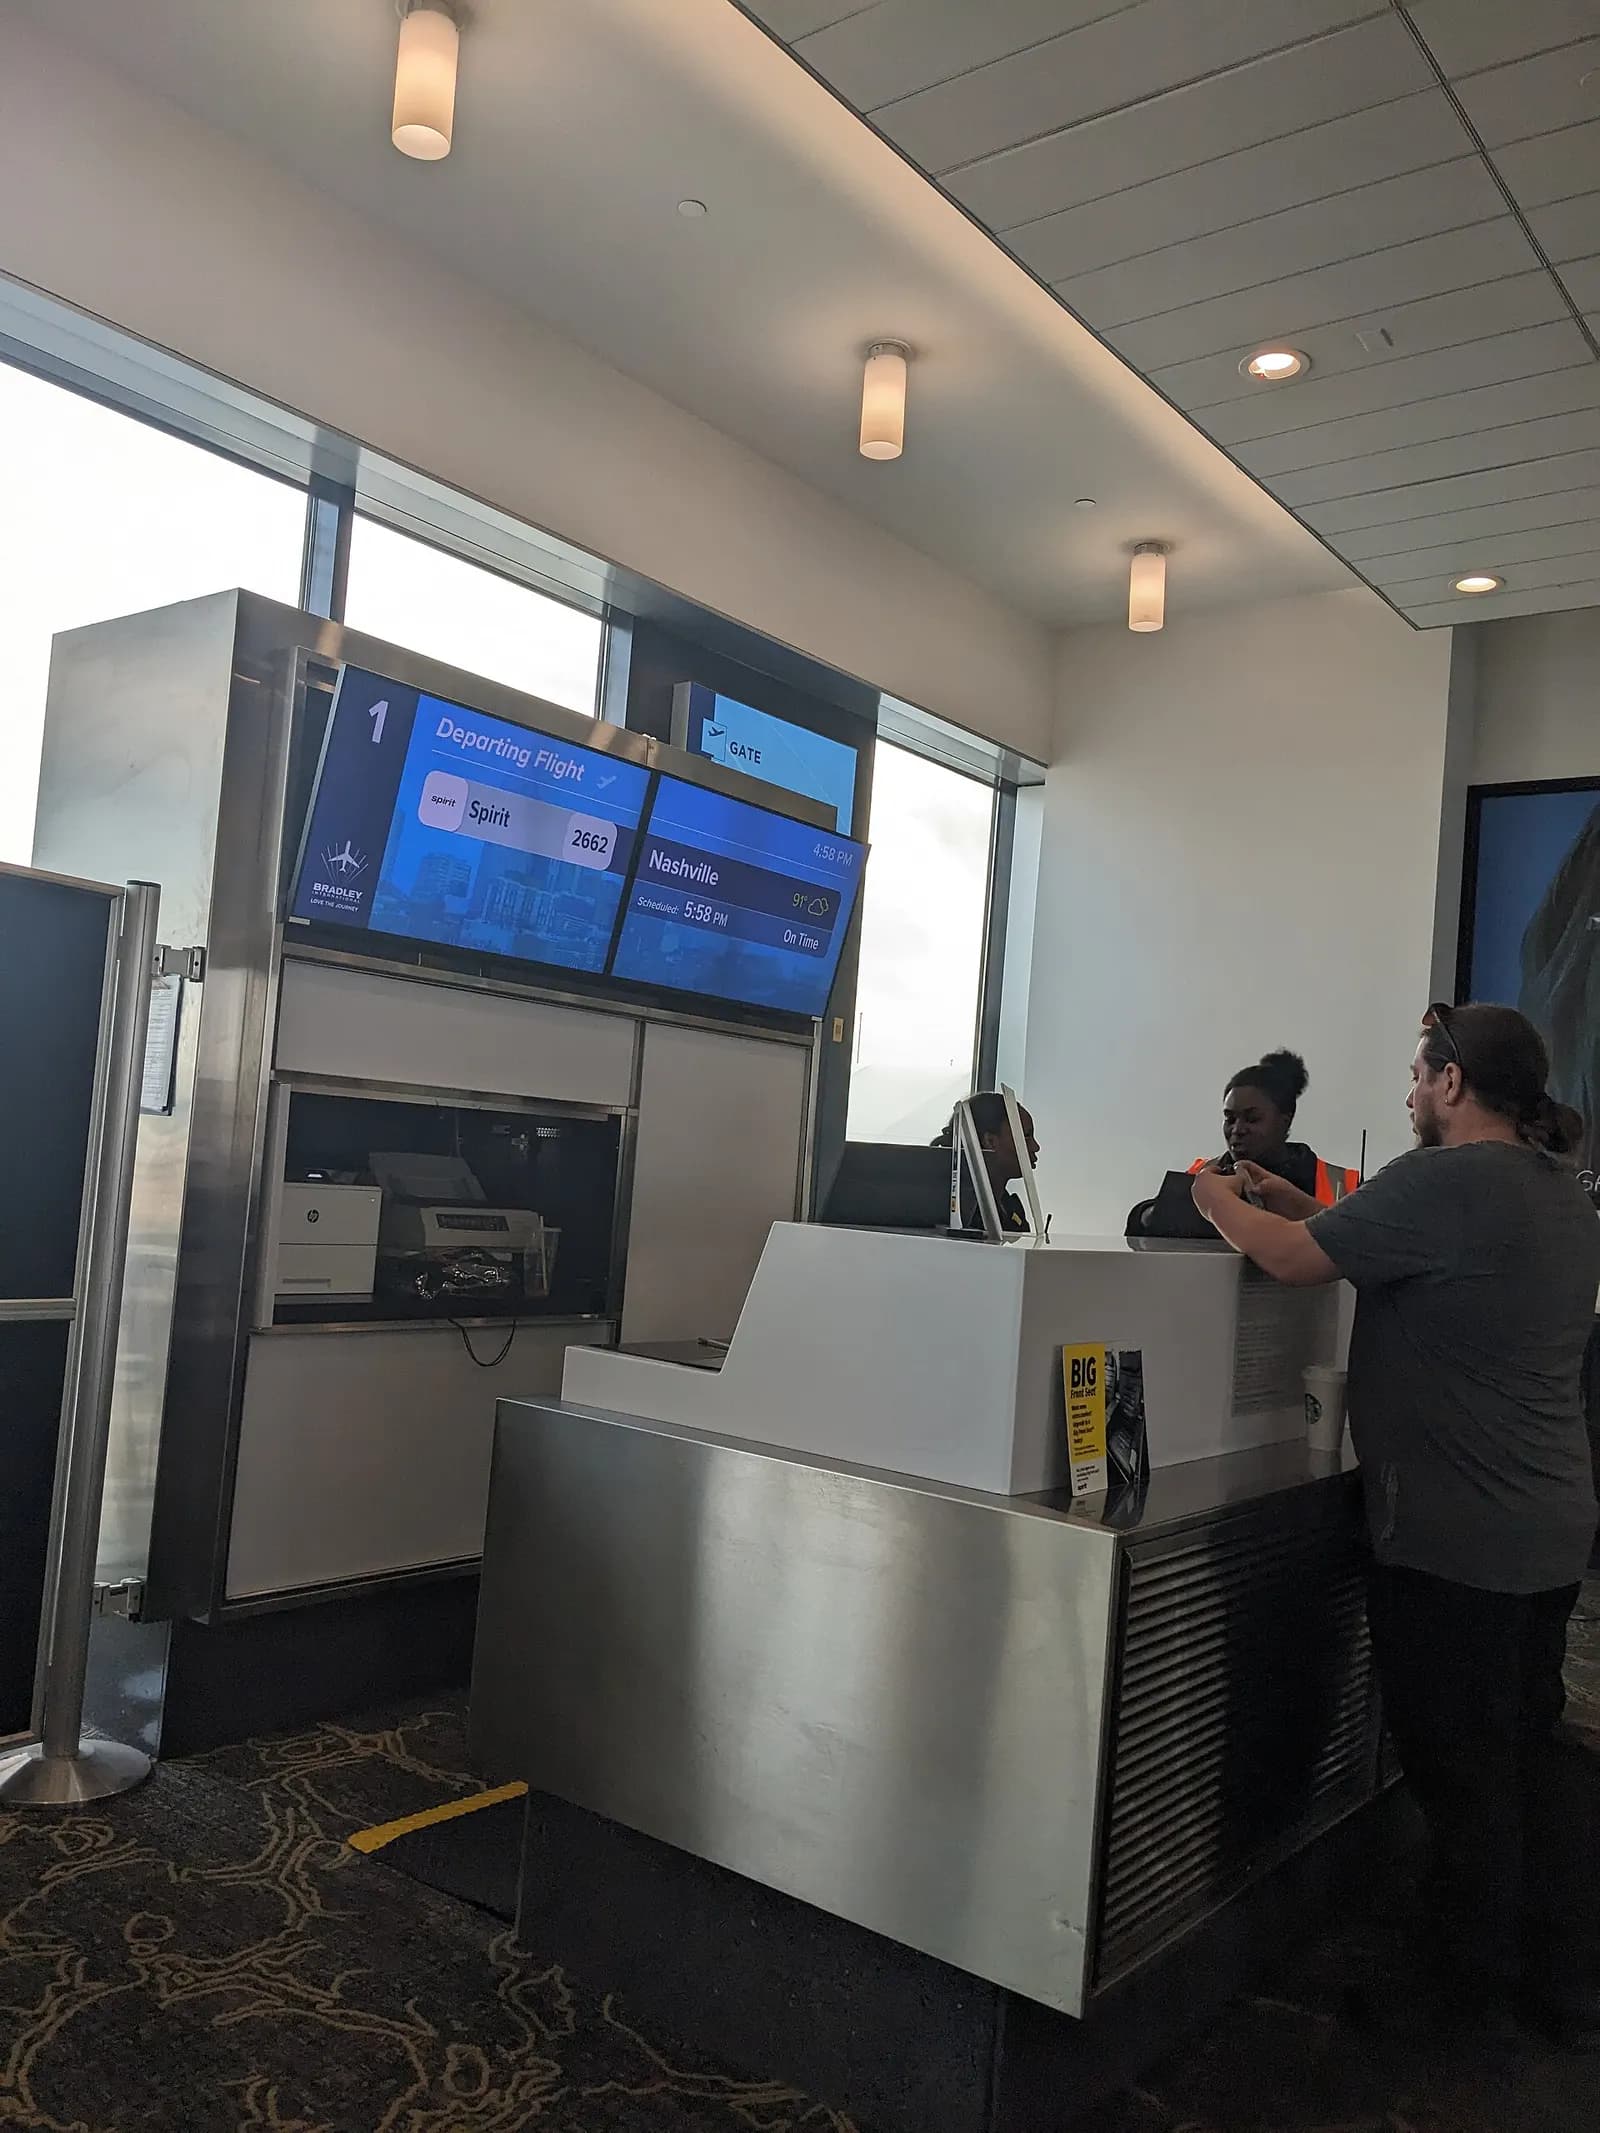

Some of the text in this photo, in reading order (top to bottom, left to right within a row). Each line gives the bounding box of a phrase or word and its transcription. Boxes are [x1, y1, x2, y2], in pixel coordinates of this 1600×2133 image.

[367, 699, 390, 745] 1
[435, 716, 586, 782] Departing Flight
[729, 741, 762, 765] GATE
[431, 794, 457, 809] spirit
[468, 799, 511, 829] Spirit
[571, 828, 609, 855] 2662
[813, 843, 854, 866] 4:58 PM
[648, 848, 720, 886] Nashville
[312, 890, 361, 903] INTERNATIONAL
[313, 882, 363, 899] BRADLEY
[310, 897, 324, 905] LOVE
[335, 903, 359, 912] JOURNEY
[637, 895, 728, 928] Scheduled: 5:58 PM
[783, 928, 819, 951] On Time
[1072, 1356, 1096, 1387] BIG
[1070, 1387, 1085, 1399] Front
